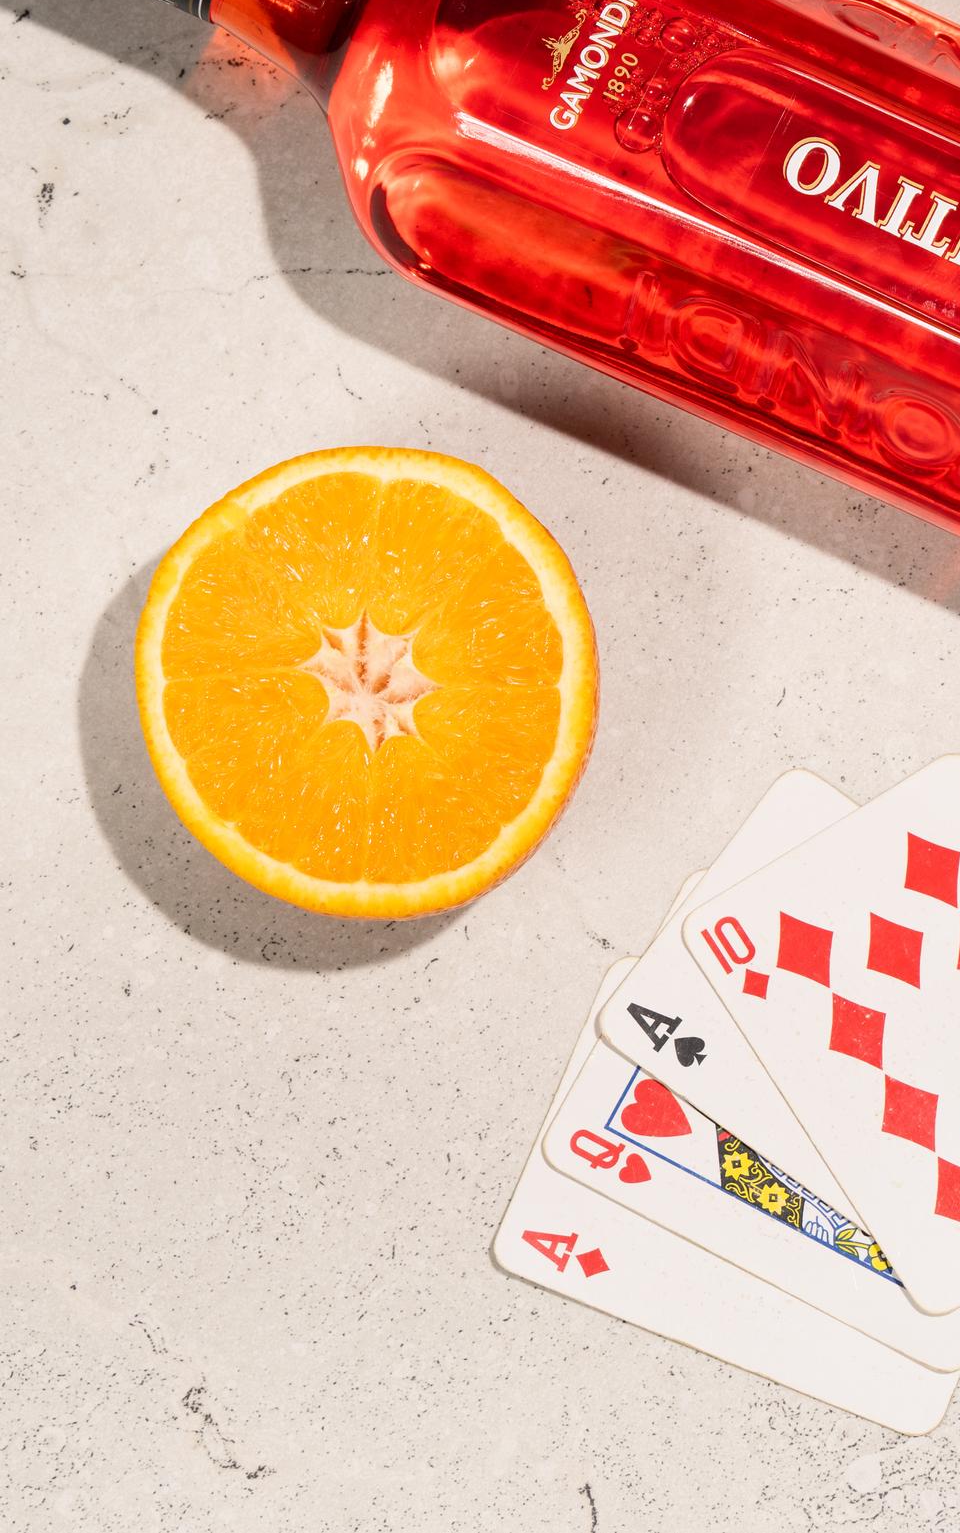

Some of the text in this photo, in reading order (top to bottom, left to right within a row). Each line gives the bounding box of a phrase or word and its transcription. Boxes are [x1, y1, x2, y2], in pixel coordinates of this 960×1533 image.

[602, 51, 639, 101] 1890
[701, 915, 757, 975] 10
[626, 1001, 683, 1053] A
[568, 1128, 626, 1171] Q
[521, 1229, 579, 1273] A
